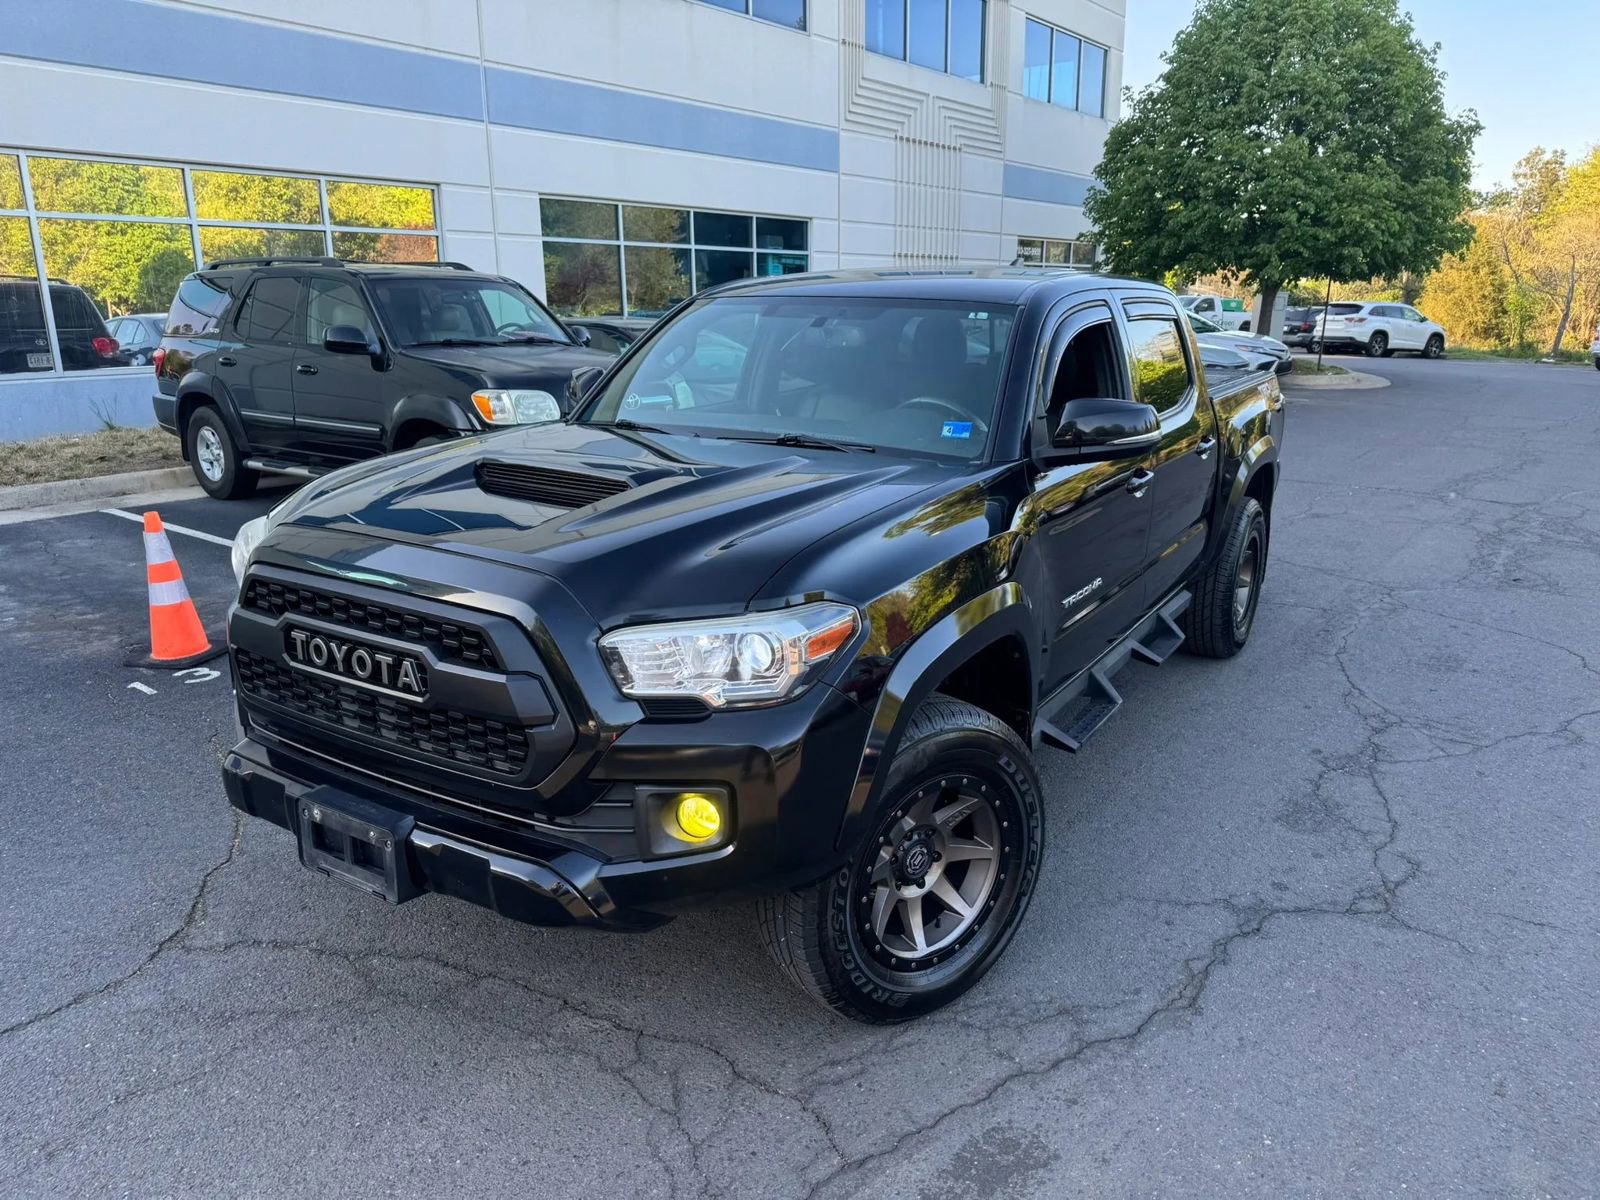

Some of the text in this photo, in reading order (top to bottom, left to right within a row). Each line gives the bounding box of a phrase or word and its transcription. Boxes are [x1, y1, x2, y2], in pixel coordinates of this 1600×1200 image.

[1061, 577, 1102, 608] TACOMA
[291, 629, 422, 692] TOYOTA
[831, 866, 912, 1008] BRIDGESTO
